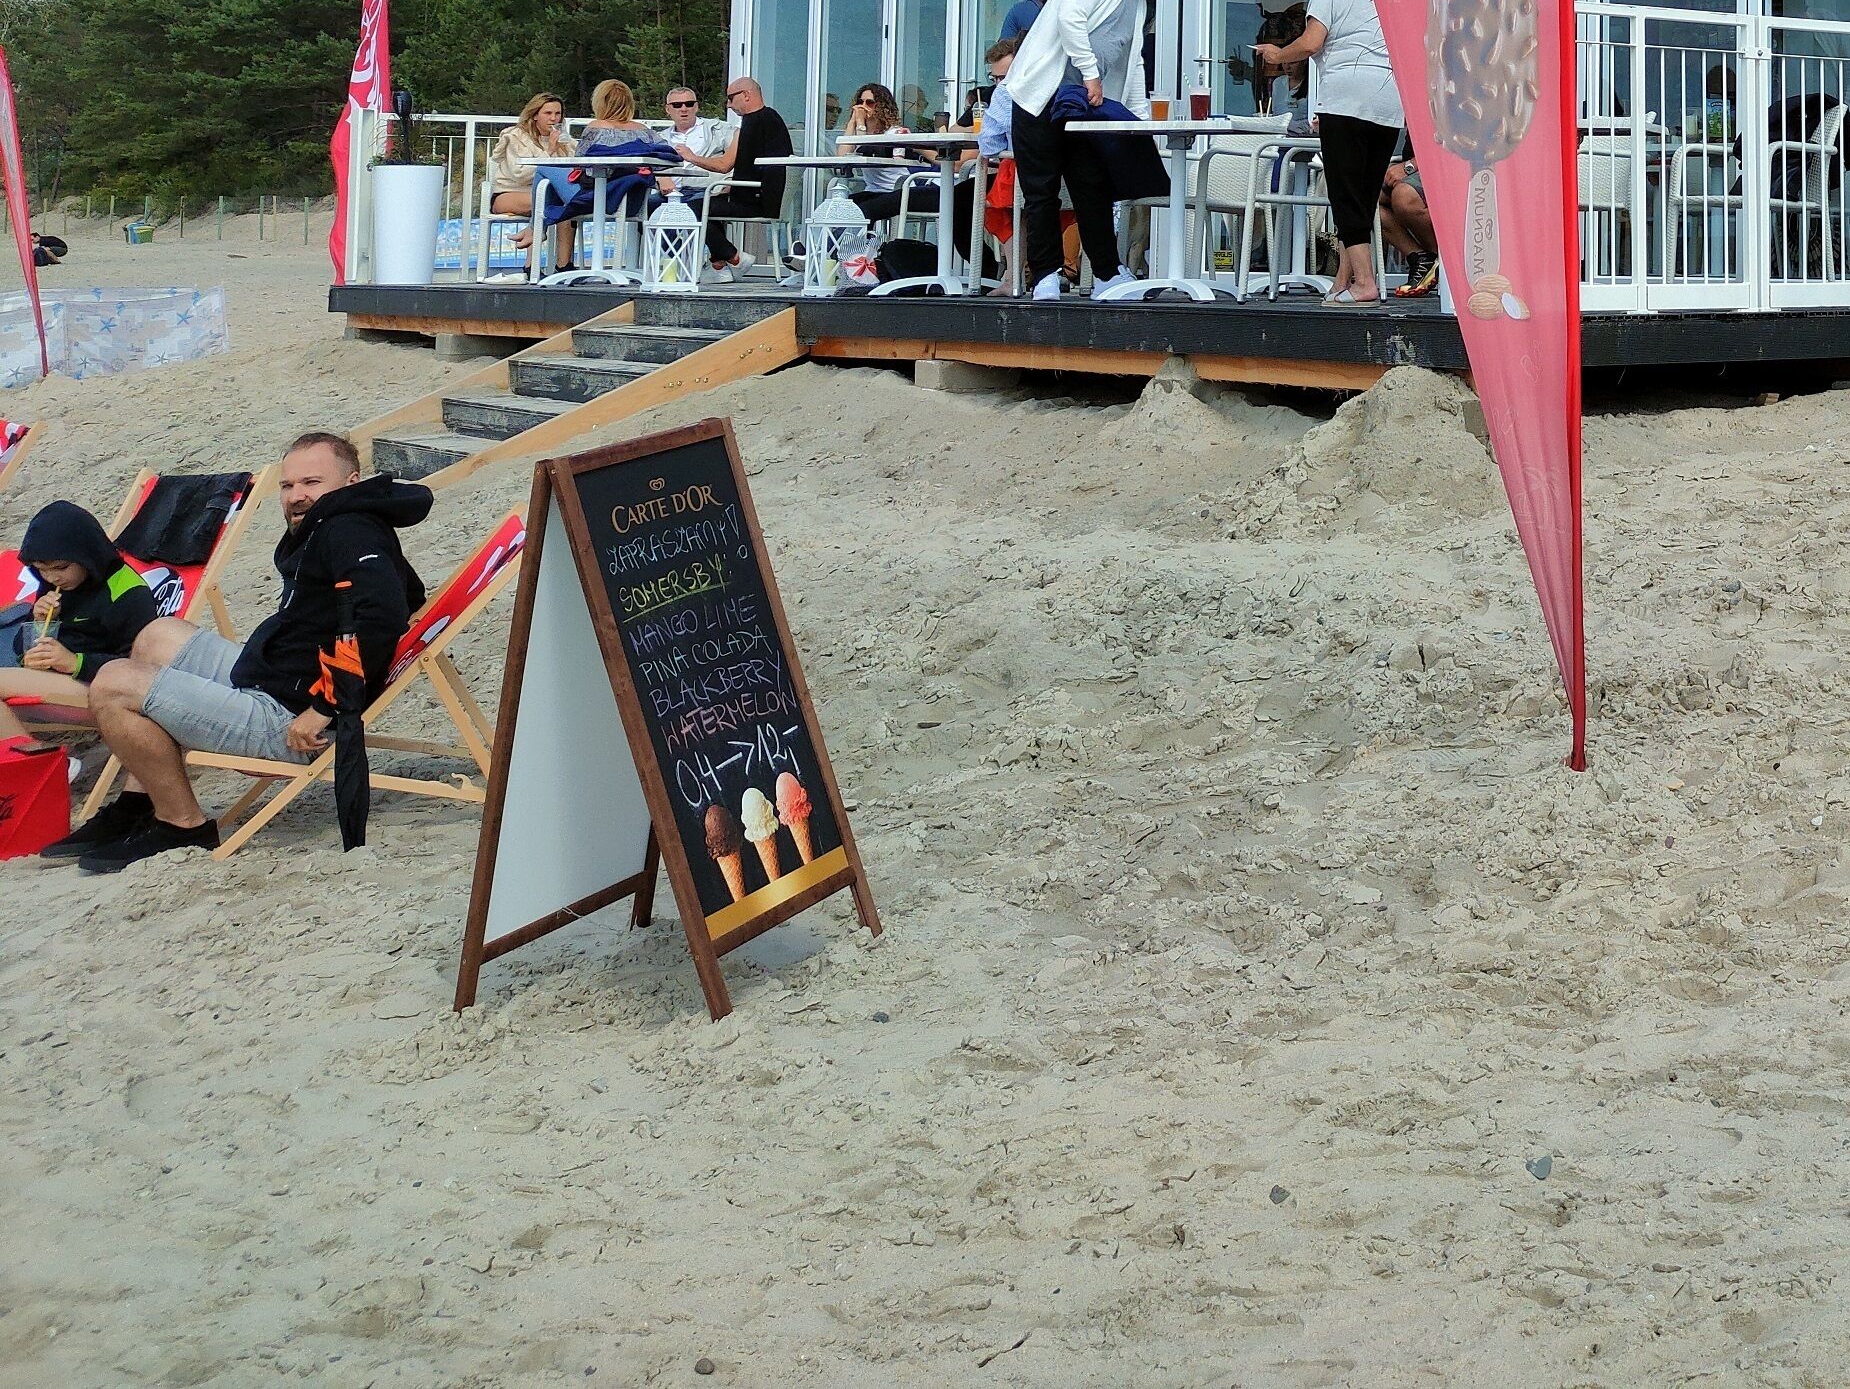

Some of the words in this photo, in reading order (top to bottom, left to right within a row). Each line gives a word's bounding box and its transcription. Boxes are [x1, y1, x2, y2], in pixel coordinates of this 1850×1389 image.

[611, 497, 671, 534] CARTE
[671, 484, 724, 514] D'OR
[628, 609, 699, 657] MANGO
[703, 593, 757, 630] LIME
[639, 645, 691, 686] PINA
[691, 624, 774, 665] COLADA
[648, 649, 782, 718] BLACKBERRY
[660, 681, 797, 755] WATERMELON
